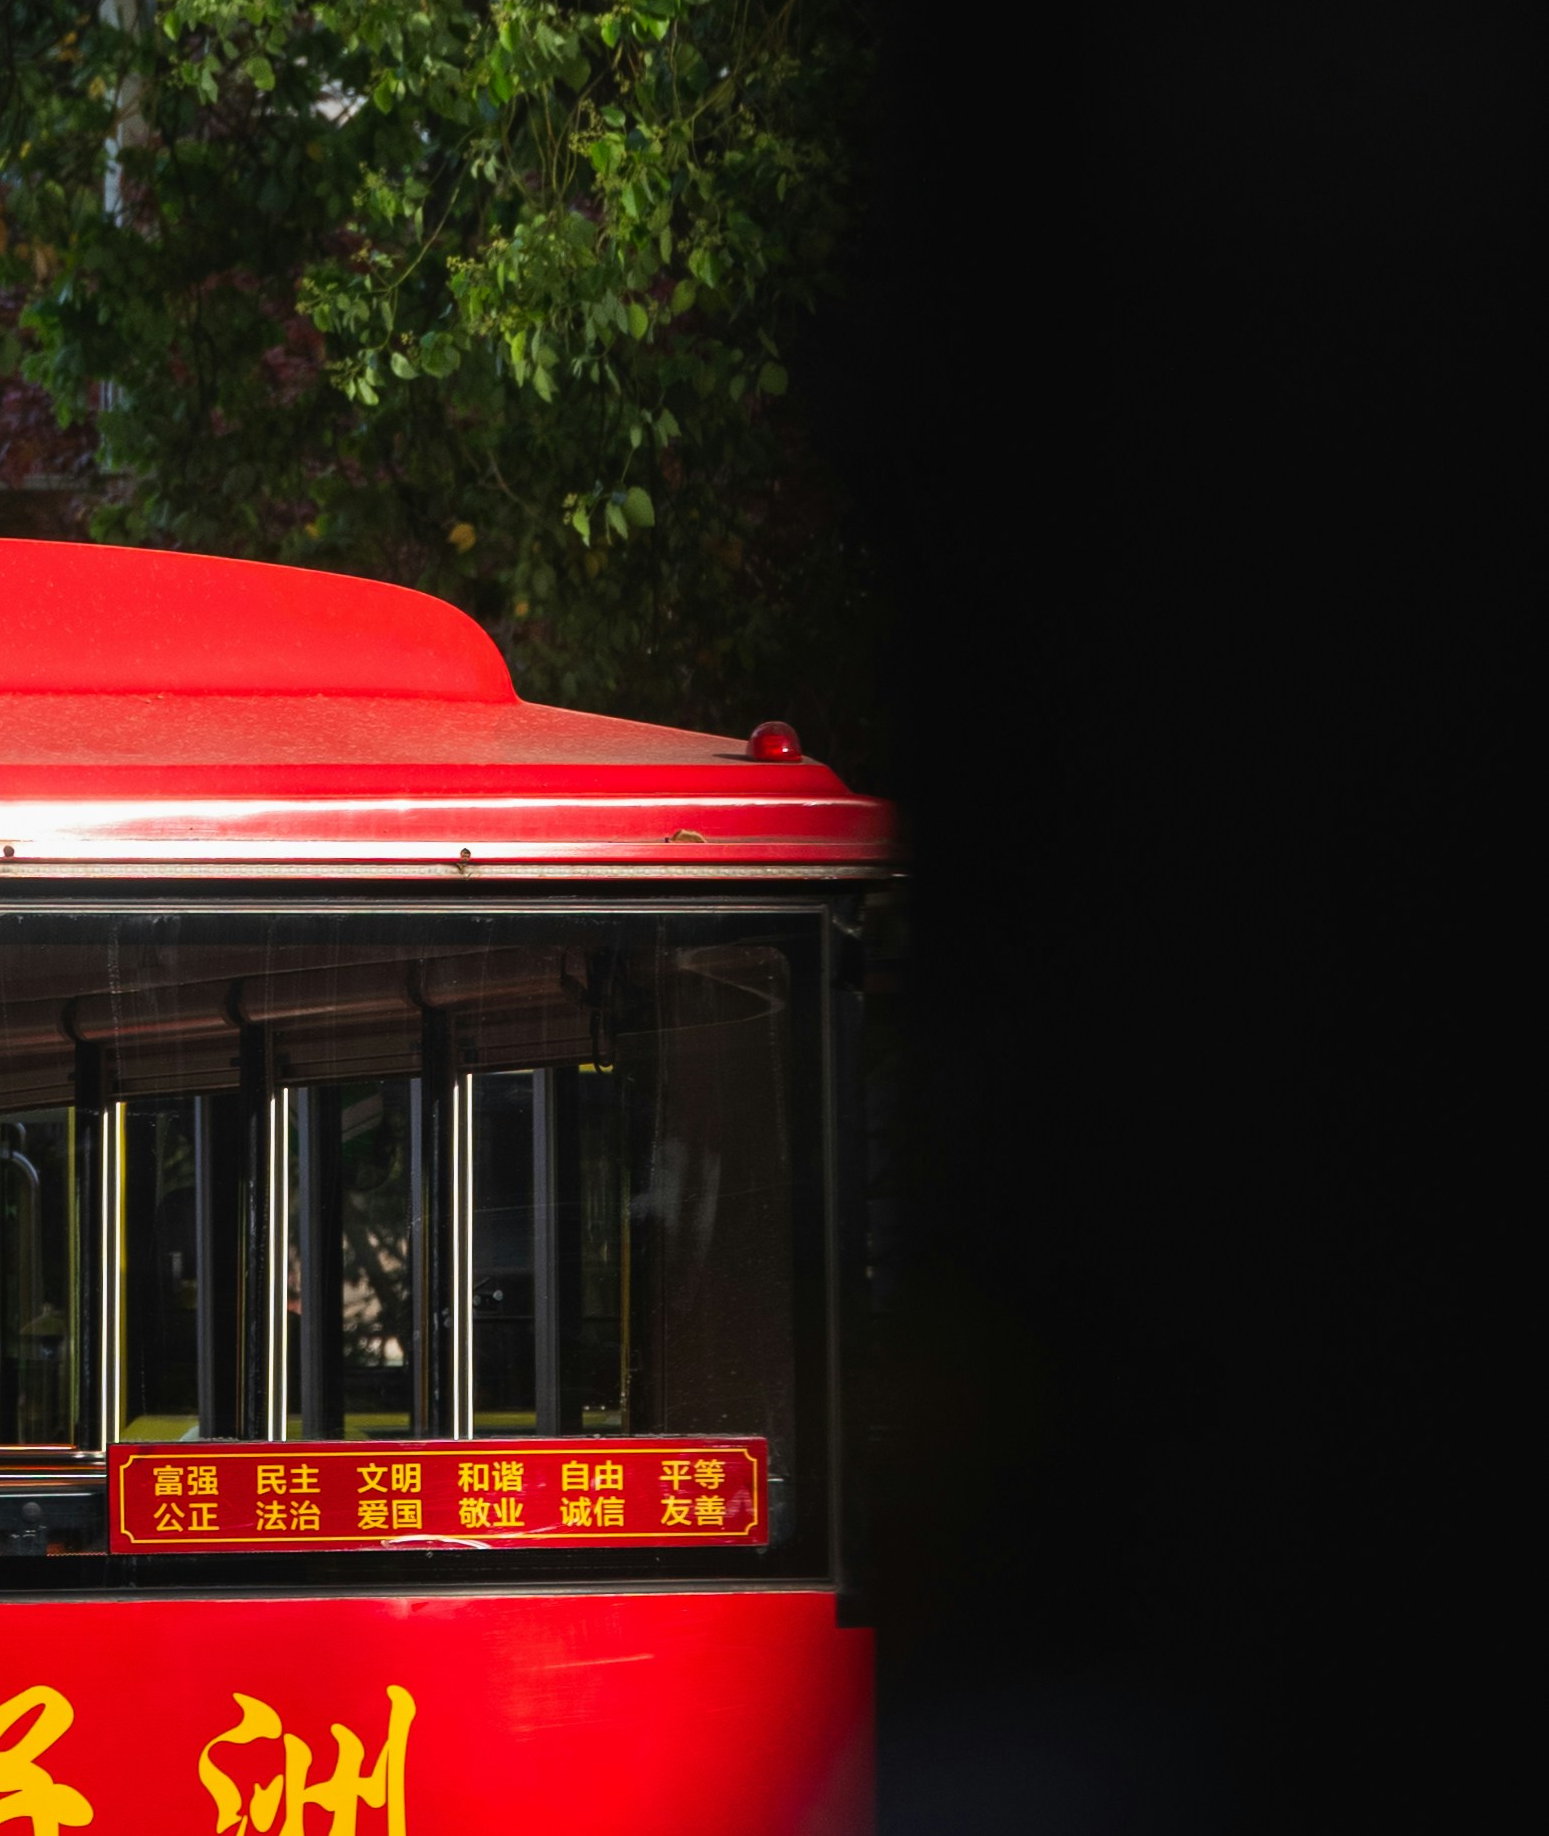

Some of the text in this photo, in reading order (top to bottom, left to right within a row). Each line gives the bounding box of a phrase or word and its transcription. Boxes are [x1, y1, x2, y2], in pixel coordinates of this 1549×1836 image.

[153, 1458, 725, 1496] 富强 民主 文明 和谐 自由 平等
[153, 1495, 725, 1533] 公正 法治 爱国 敬业 诚信 友善
